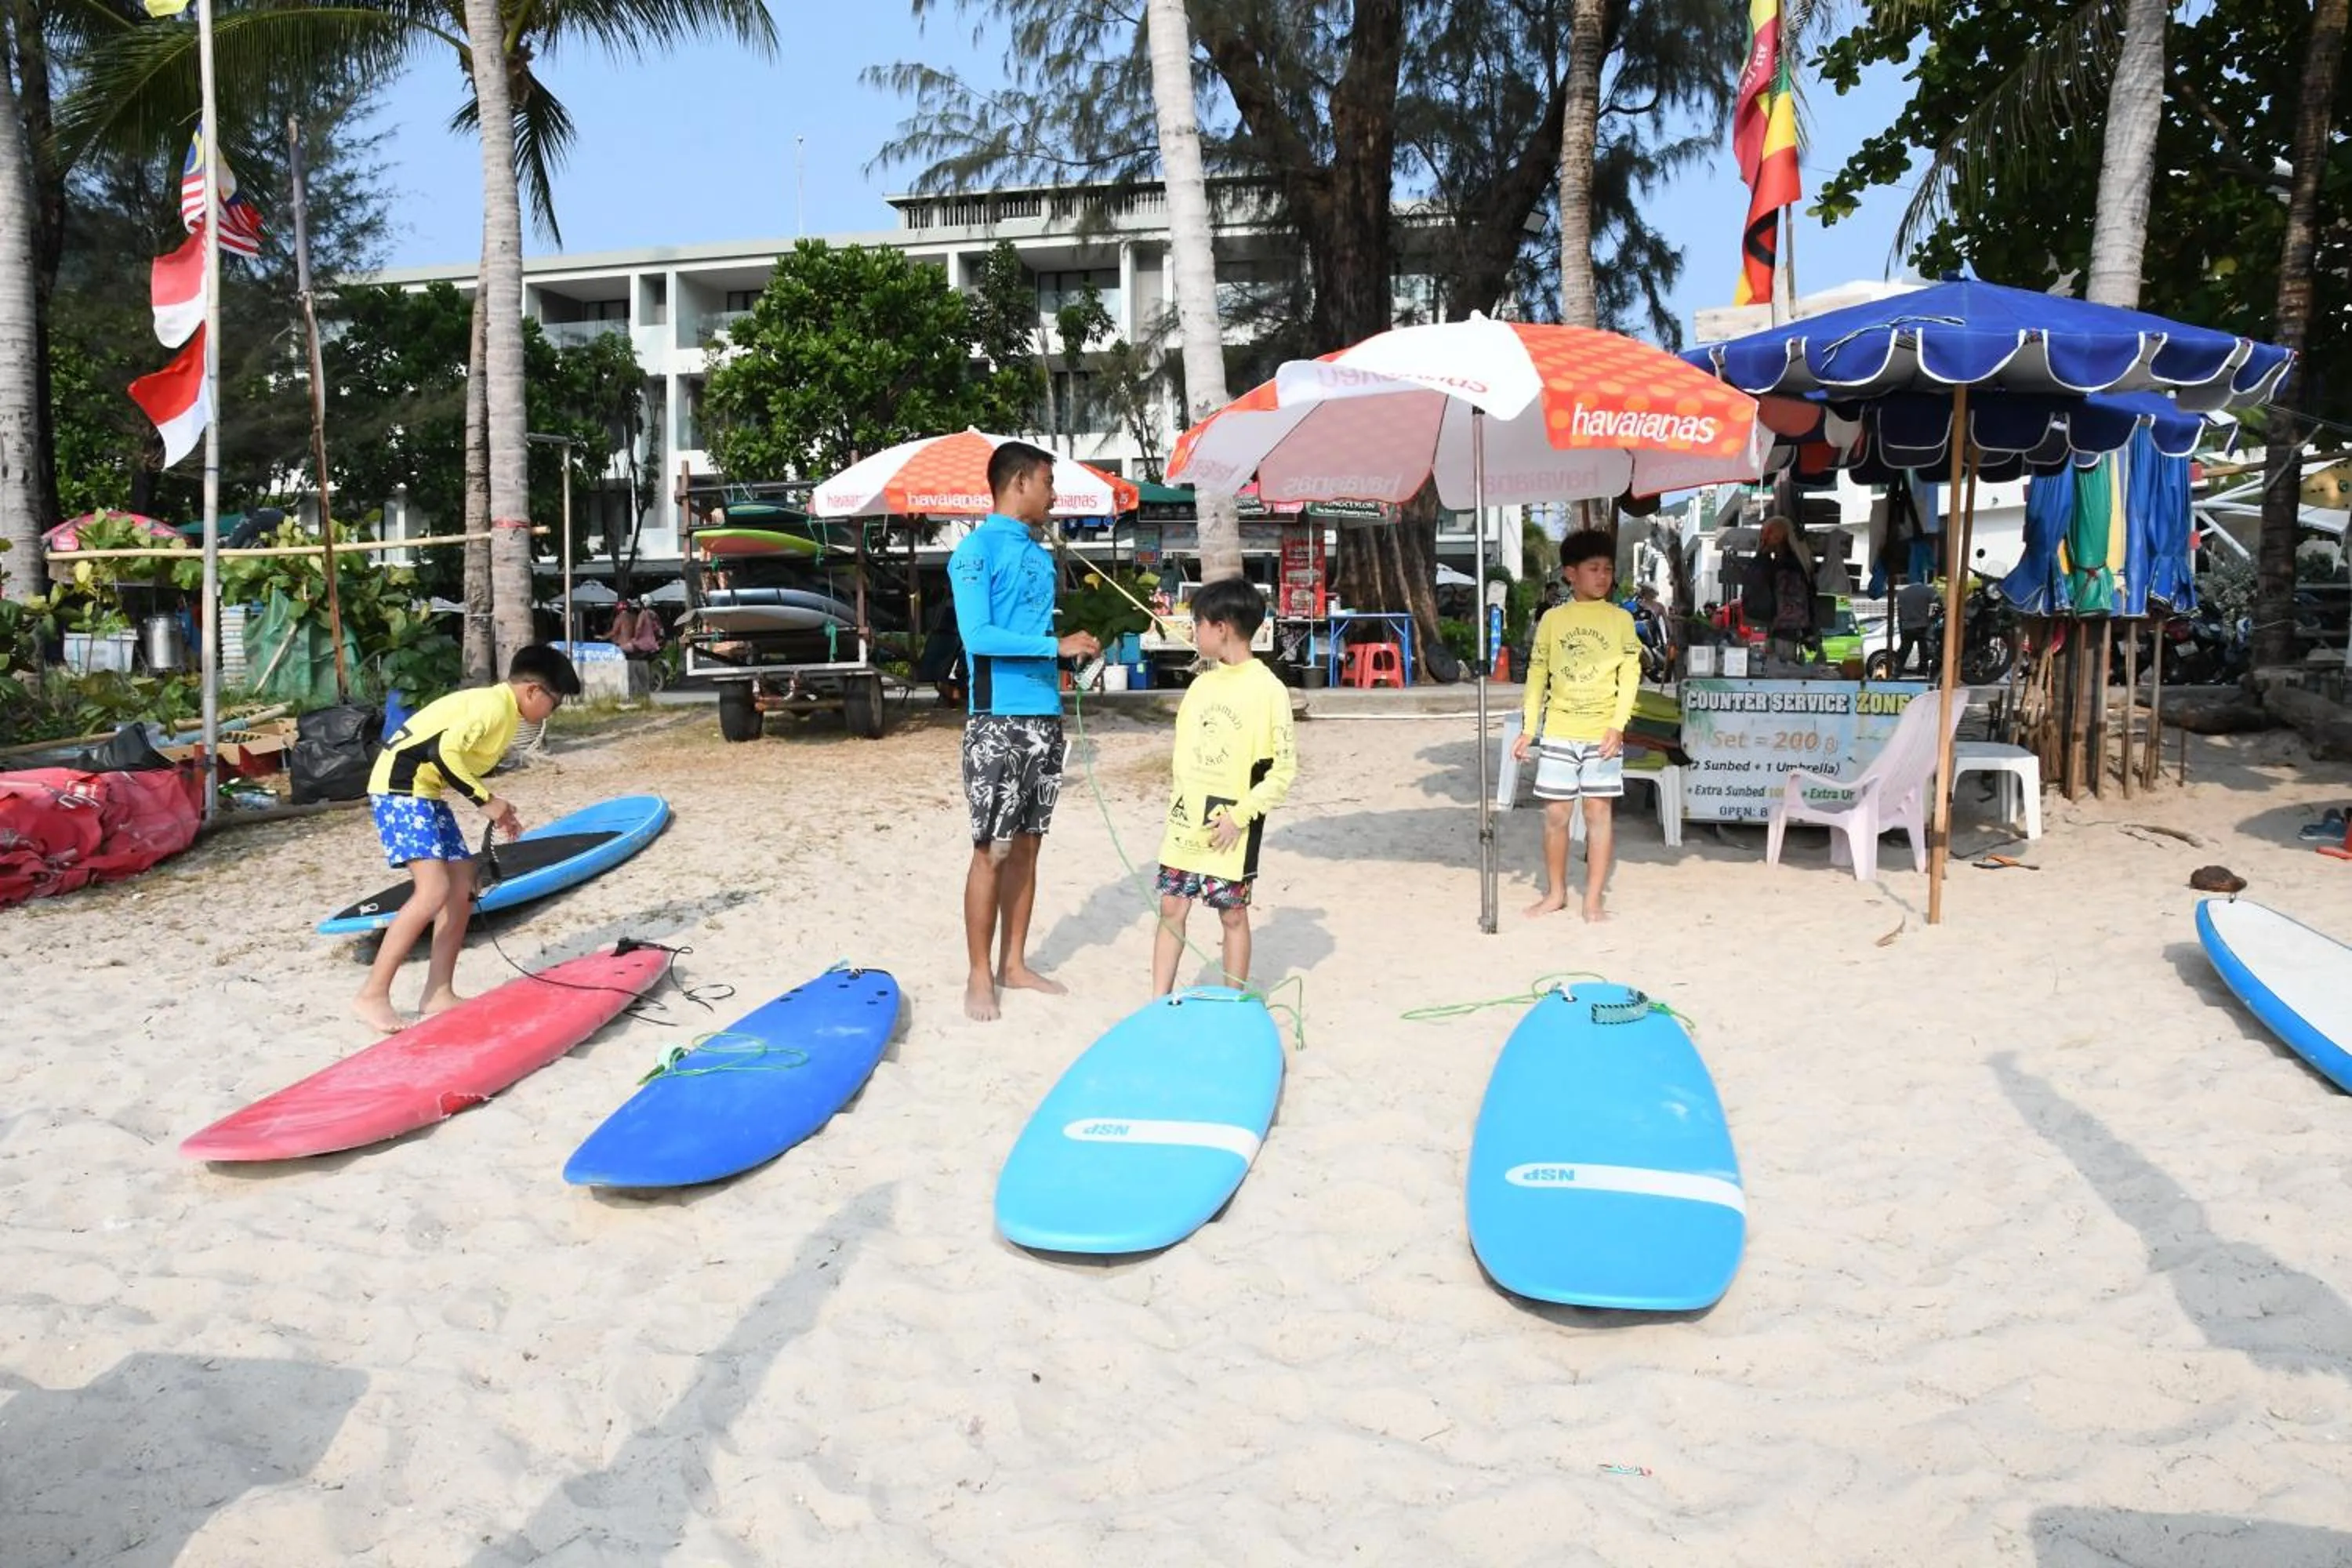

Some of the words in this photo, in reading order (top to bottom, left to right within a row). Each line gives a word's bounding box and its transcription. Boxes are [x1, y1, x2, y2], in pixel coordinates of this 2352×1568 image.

[1572, 402, 1716, 444] havaianas
[907, 492, 993, 508] havaianas
[1054, 494, 1098, 509] aianas
[1686, 691, 1768, 712] COUNTER
[1772, 693, 1849, 713] SERVICE
[1712, 730, 1748, 749] Set
[1773, 730, 1818, 751] 200
[1704, 760, 1751, 771] Sunbed
[1694, 785, 1723, 797] Extra
[1725, 785, 1766, 797] Sunbed
[1809, 788, 1839, 799] Extra
[1082, 1123, 1131, 1136] NSP
[1523, 1168, 1575, 1181] NSP
